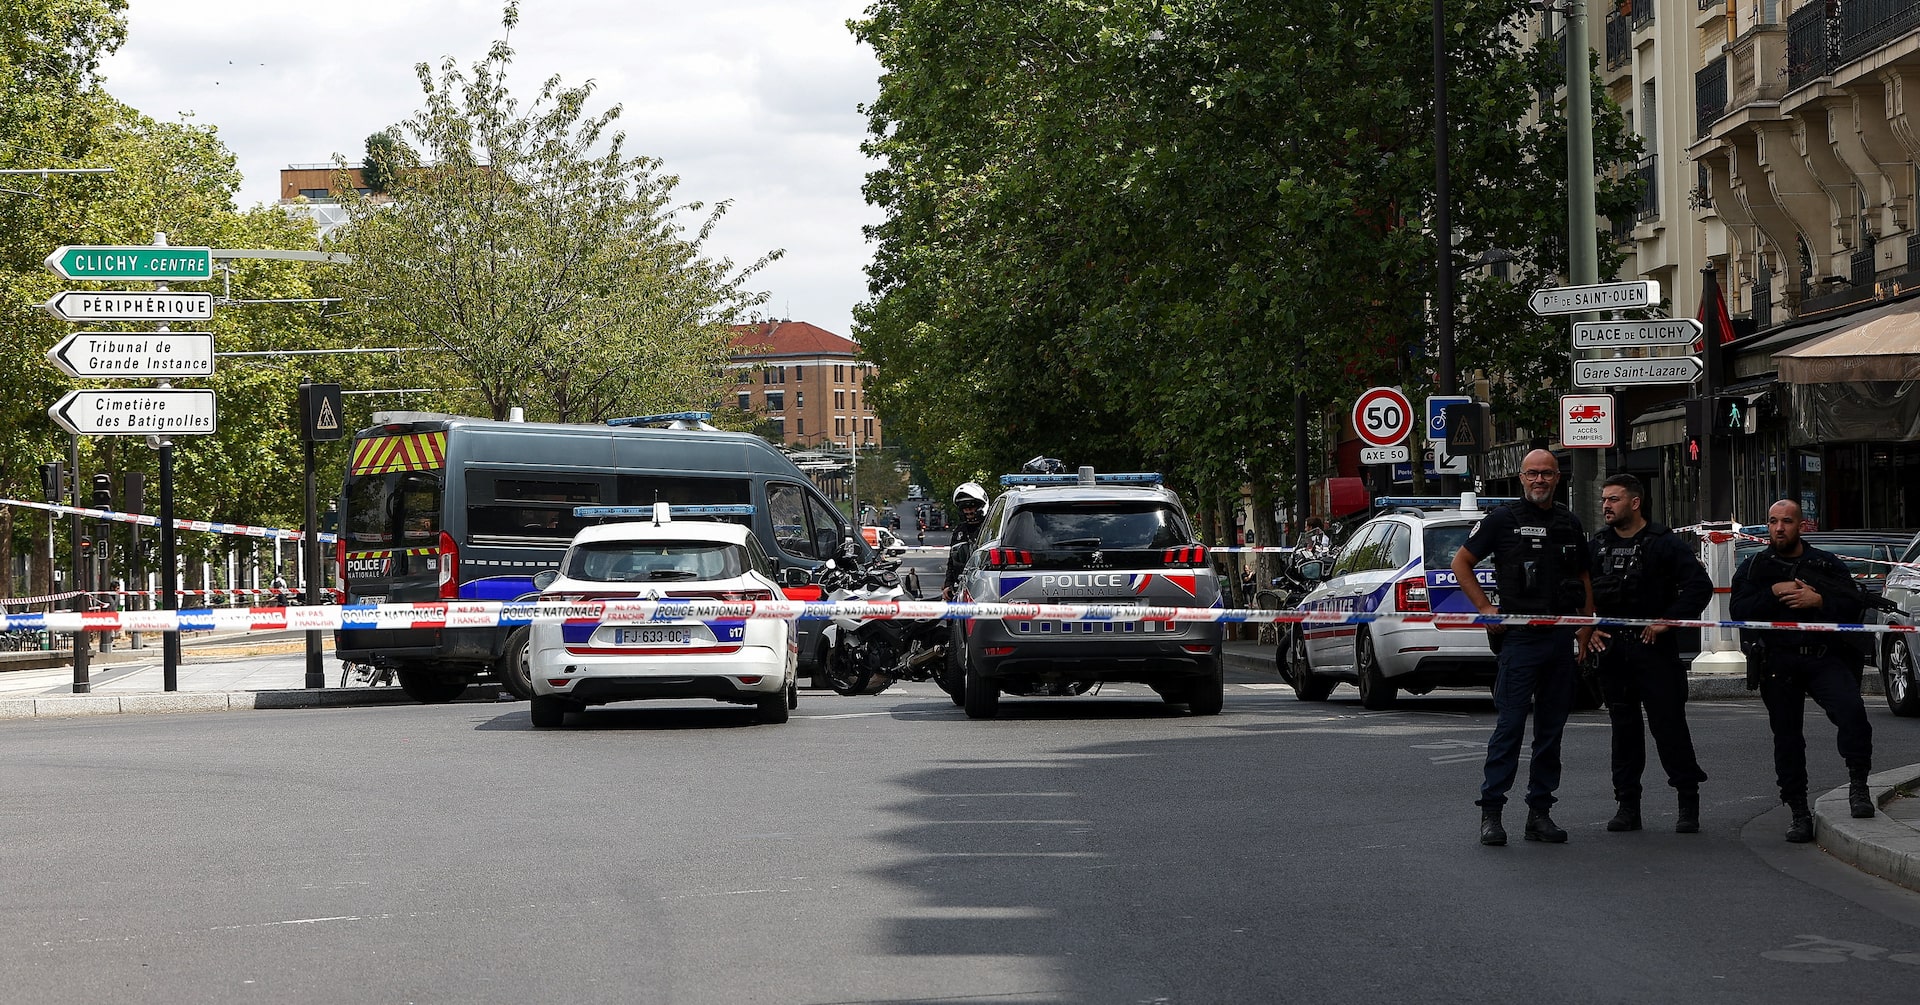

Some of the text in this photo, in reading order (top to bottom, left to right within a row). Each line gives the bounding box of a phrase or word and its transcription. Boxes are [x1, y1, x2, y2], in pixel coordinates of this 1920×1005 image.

[75, 255, 138, 271] CLICHY
[1575, 289, 1643, 305] SAINT-OUEN
[84, 297, 206, 313] PÉRIPHÉRIQUE
[1581, 326, 1684, 341] PLACE DE CLICHY
[89, 340, 171, 353] Tribunal de
[89, 357, 208, 370] Grande Instance
[1583, 364, 1687, 380] Gare Saint-Lazare
[96, 398, 166, 411] Cimetière
[96, 414, 209, 429] des Batignolles
[1367, 406, 1401, 430] 50
[1366, 450, 1404, 460] AXE 50
[347, 559, 379, 571] POLICE
[348, 571, 380, 579] NATIONALE
[1041, 574, 1122, 588] POLICE
[1435, 572, 1497, 585] POCE
[1041, 588, 1122, 596] NATIONALE
[343, 608, 445, 623] POLICE NATIONALE
[503, 604, 601, 618] POLICE NATIONALE
[658, 605, 752, 617] POLICE NATIONALE
[807, 605, 897, 616] POLICE NATIONALE
[985, 605, 1038, 616] NATIONALE
